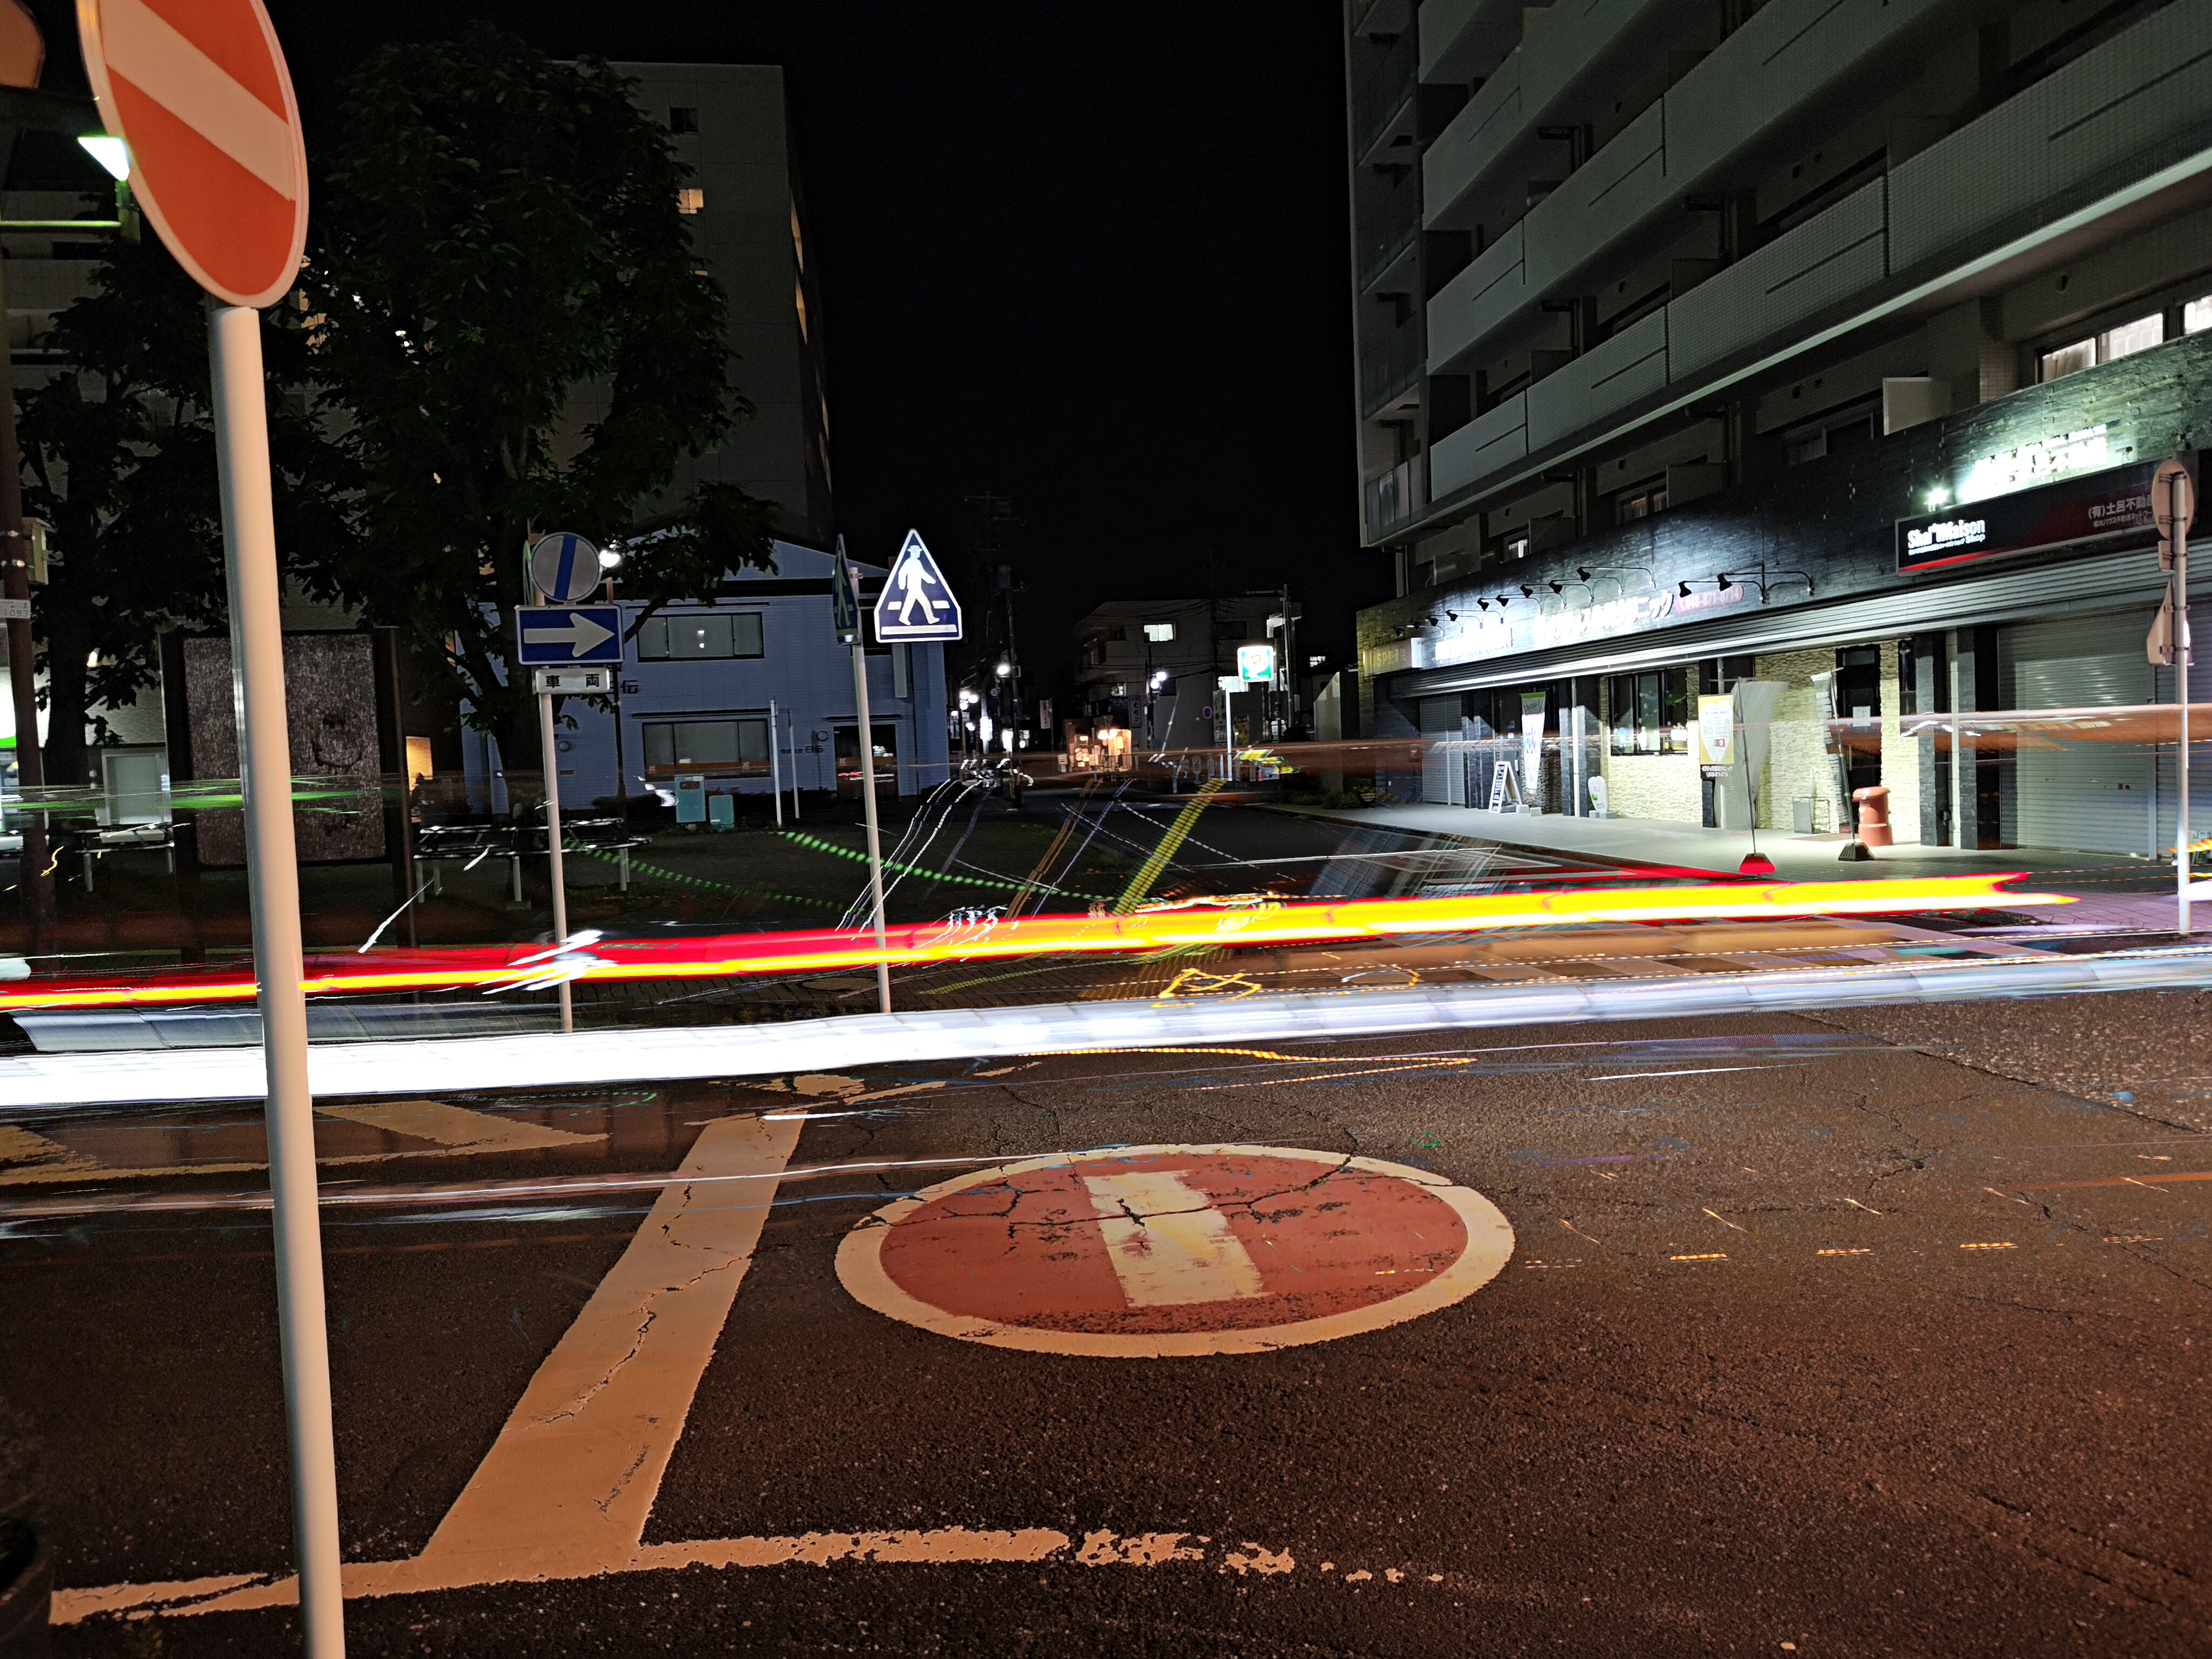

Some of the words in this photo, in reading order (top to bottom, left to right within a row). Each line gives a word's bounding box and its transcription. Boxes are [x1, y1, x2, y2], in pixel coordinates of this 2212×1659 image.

[1965, 533, 1986, 544] Shop
[1685, 587, 1739, 610] 048-871-8714
[5, 609, 28, 617] 1093
